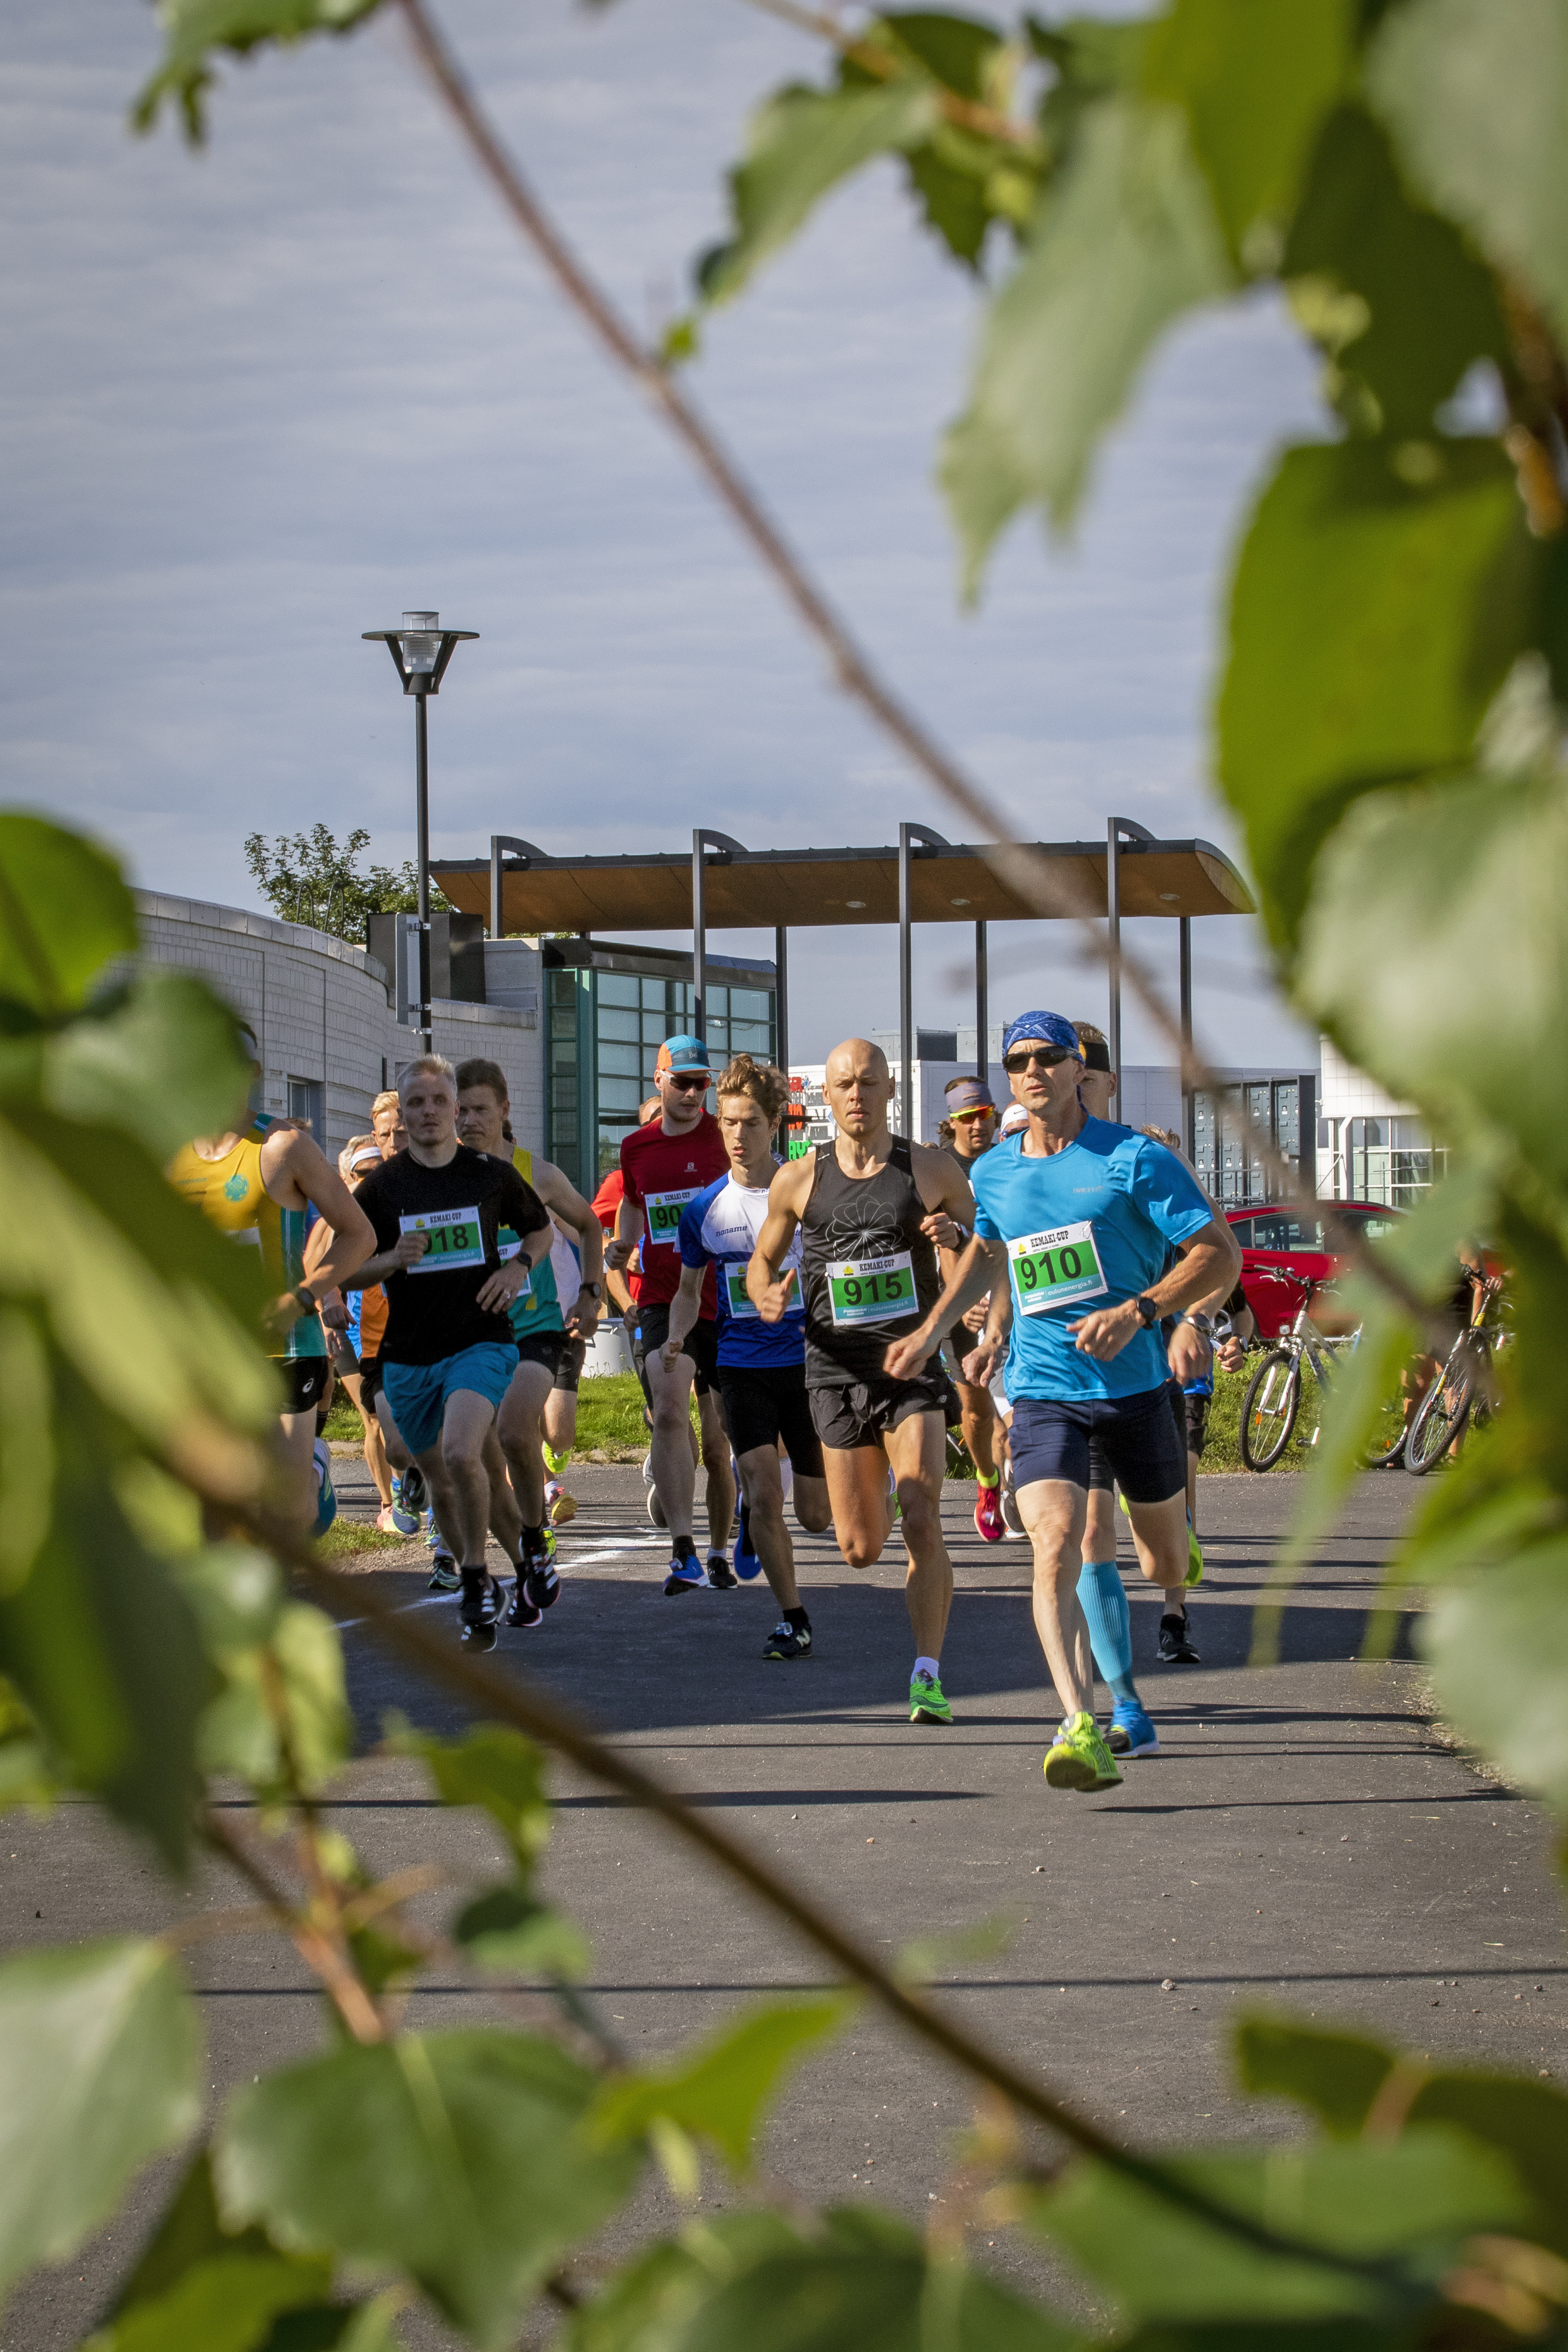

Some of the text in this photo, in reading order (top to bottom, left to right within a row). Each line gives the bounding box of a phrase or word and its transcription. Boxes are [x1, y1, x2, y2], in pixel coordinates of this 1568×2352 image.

[656, 1205, 682, 1228] 90
[715, 1225, 747, 1237] noname
[1030, 1230, 1069, 1248] KEMAKI-CUP
[859, 1259, 895, 1272] KEMAKI-CUP
[1020, 1247, 1081, 1289] 910
[843, 1272, 903, 1305] 915
[1047, 1280, 1093, 1296] oulunenergia.fi
